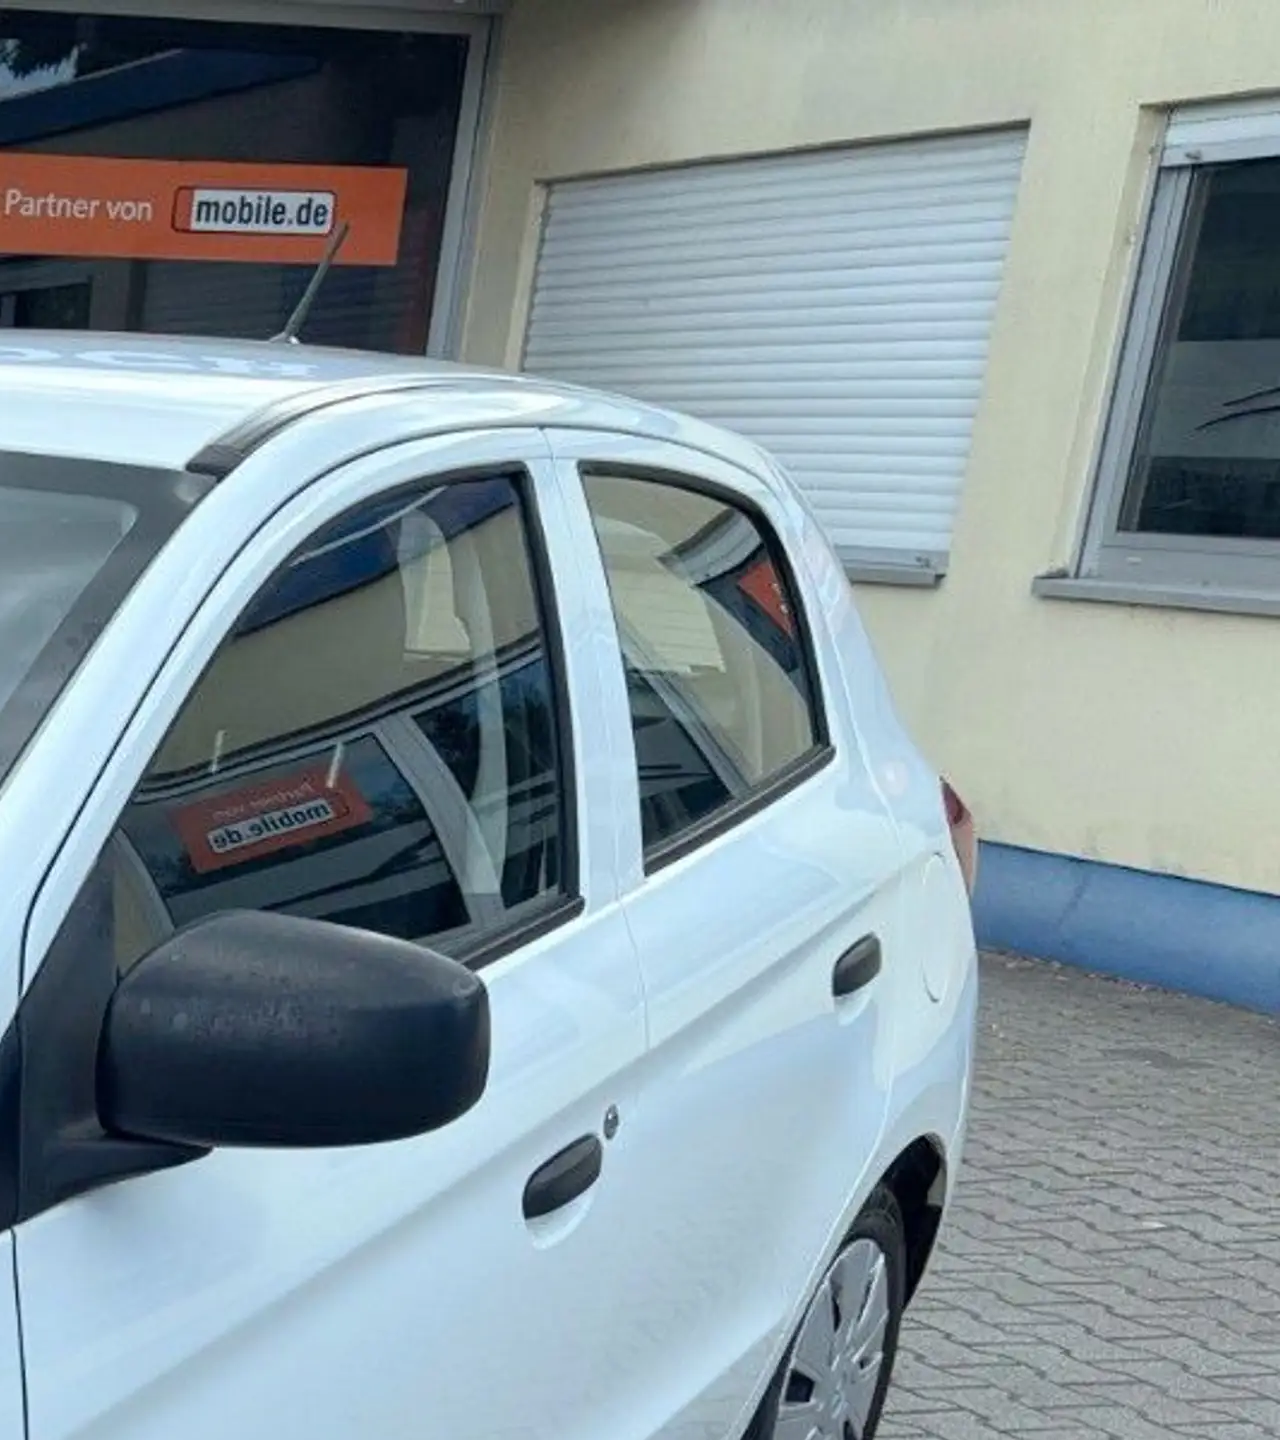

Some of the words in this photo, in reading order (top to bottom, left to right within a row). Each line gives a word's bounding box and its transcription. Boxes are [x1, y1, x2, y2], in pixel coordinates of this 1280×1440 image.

[4, 188, 99, 220] Partner
[105, 200, 152, 222] von
[194, 194, 329, 228] mobile.de
